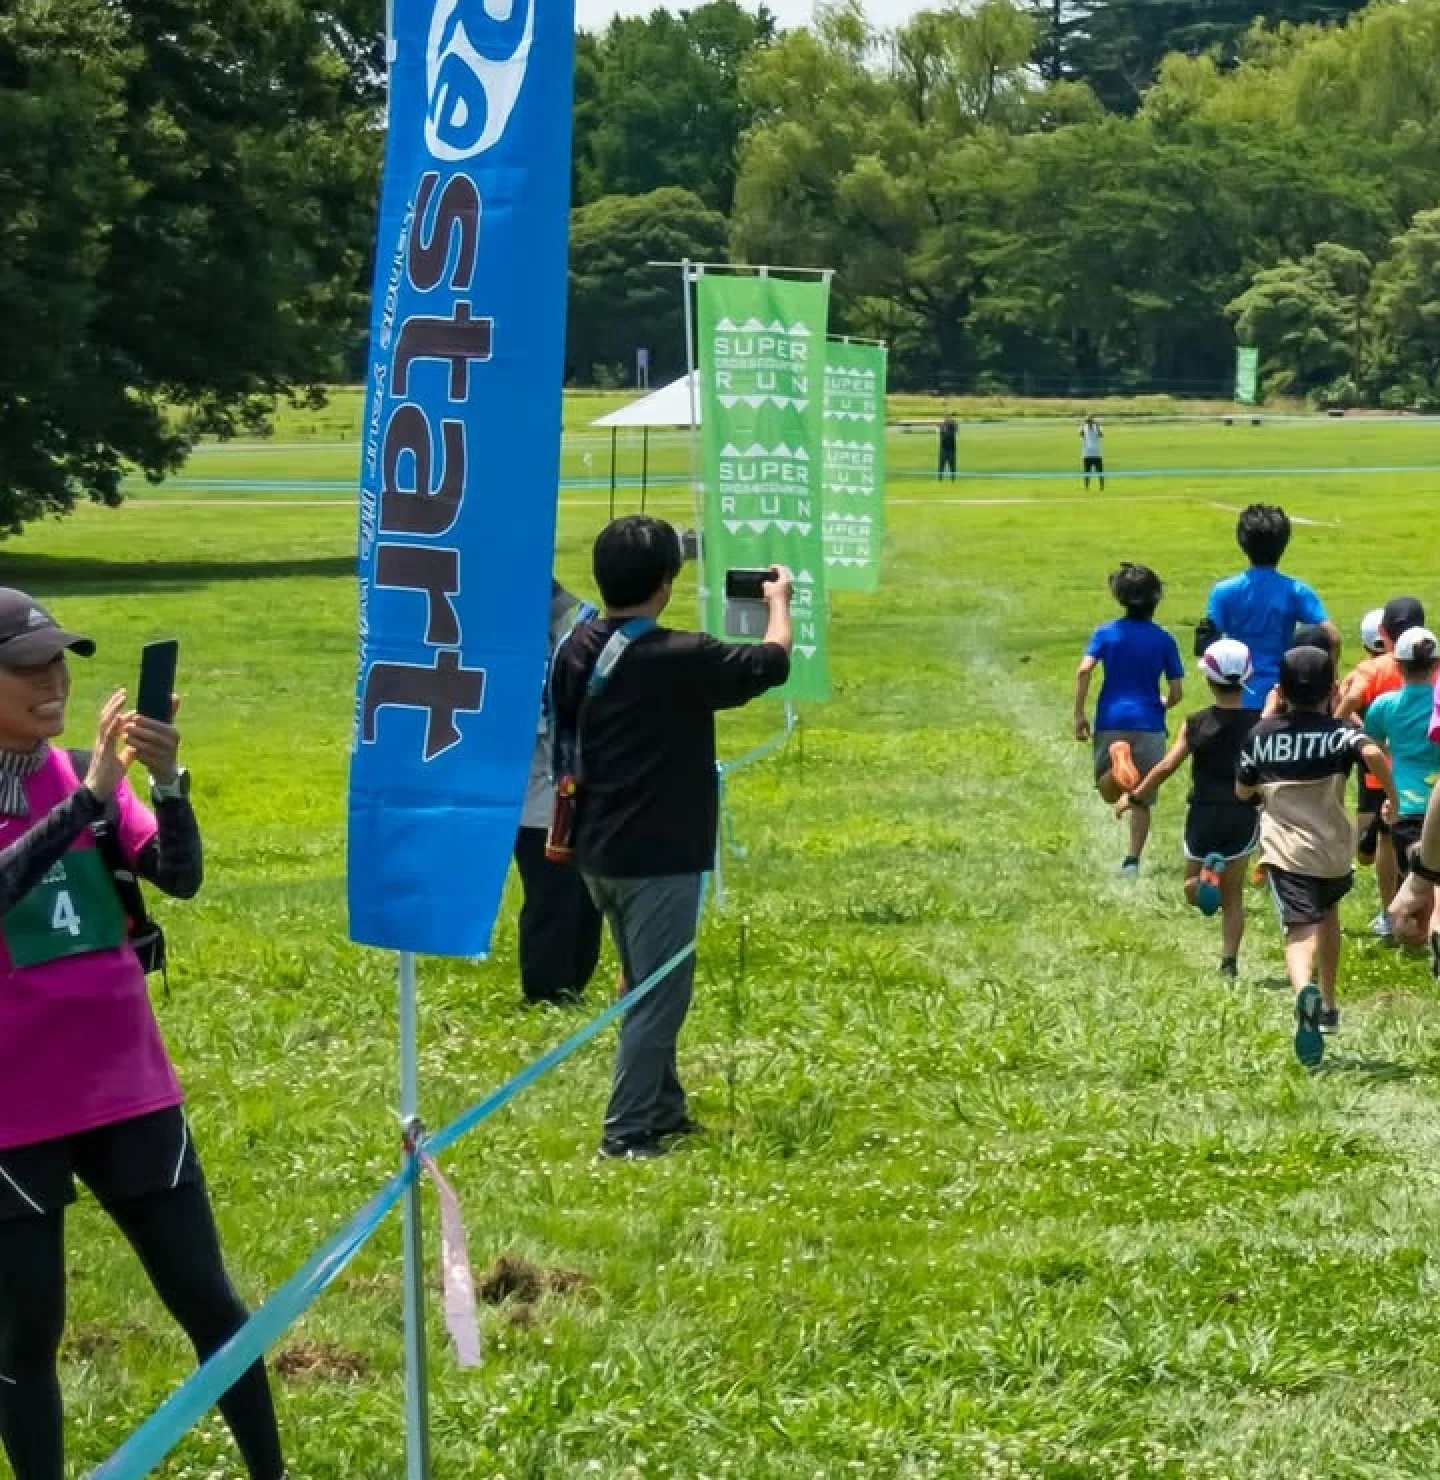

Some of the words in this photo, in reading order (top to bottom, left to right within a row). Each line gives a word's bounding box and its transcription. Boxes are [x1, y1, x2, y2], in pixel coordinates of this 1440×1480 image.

[713, 337, 808, 361] SUPER
[715, 371, 809, 394] RUN
[720, 461, 809, 484] SUPER
[721, 495, 811, 518] RUN
[52, 890, 81, 937] 4
